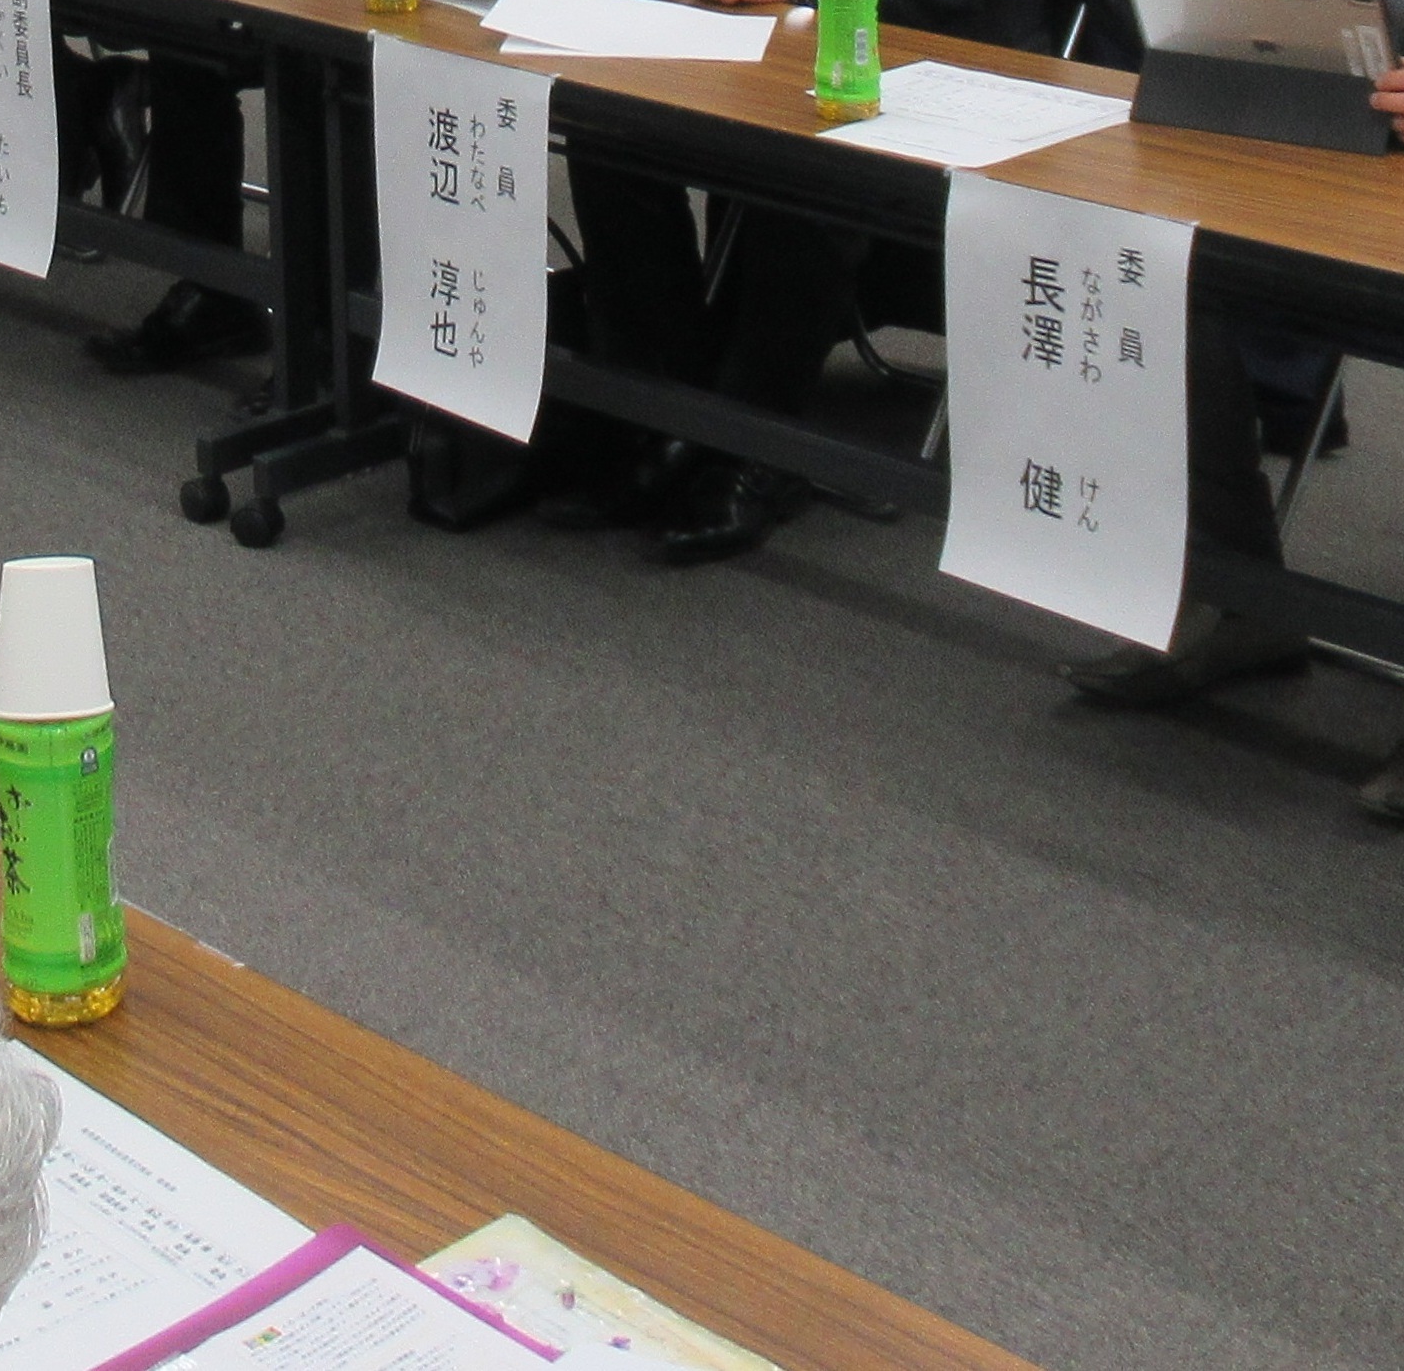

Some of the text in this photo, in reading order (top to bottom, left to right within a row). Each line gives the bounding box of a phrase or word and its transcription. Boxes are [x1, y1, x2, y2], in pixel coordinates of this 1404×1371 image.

[429, 106, 460, 358] 渡辺 淳也
[497, 97, 518, 201] 委員
[470, 270, 486, 369] じゅんや
[1020, 255, 1066, 521] 長澤 健
[1077, 267, 1102, 533] ながさわ けん
[1117, 247, 1146, 369] 委員
